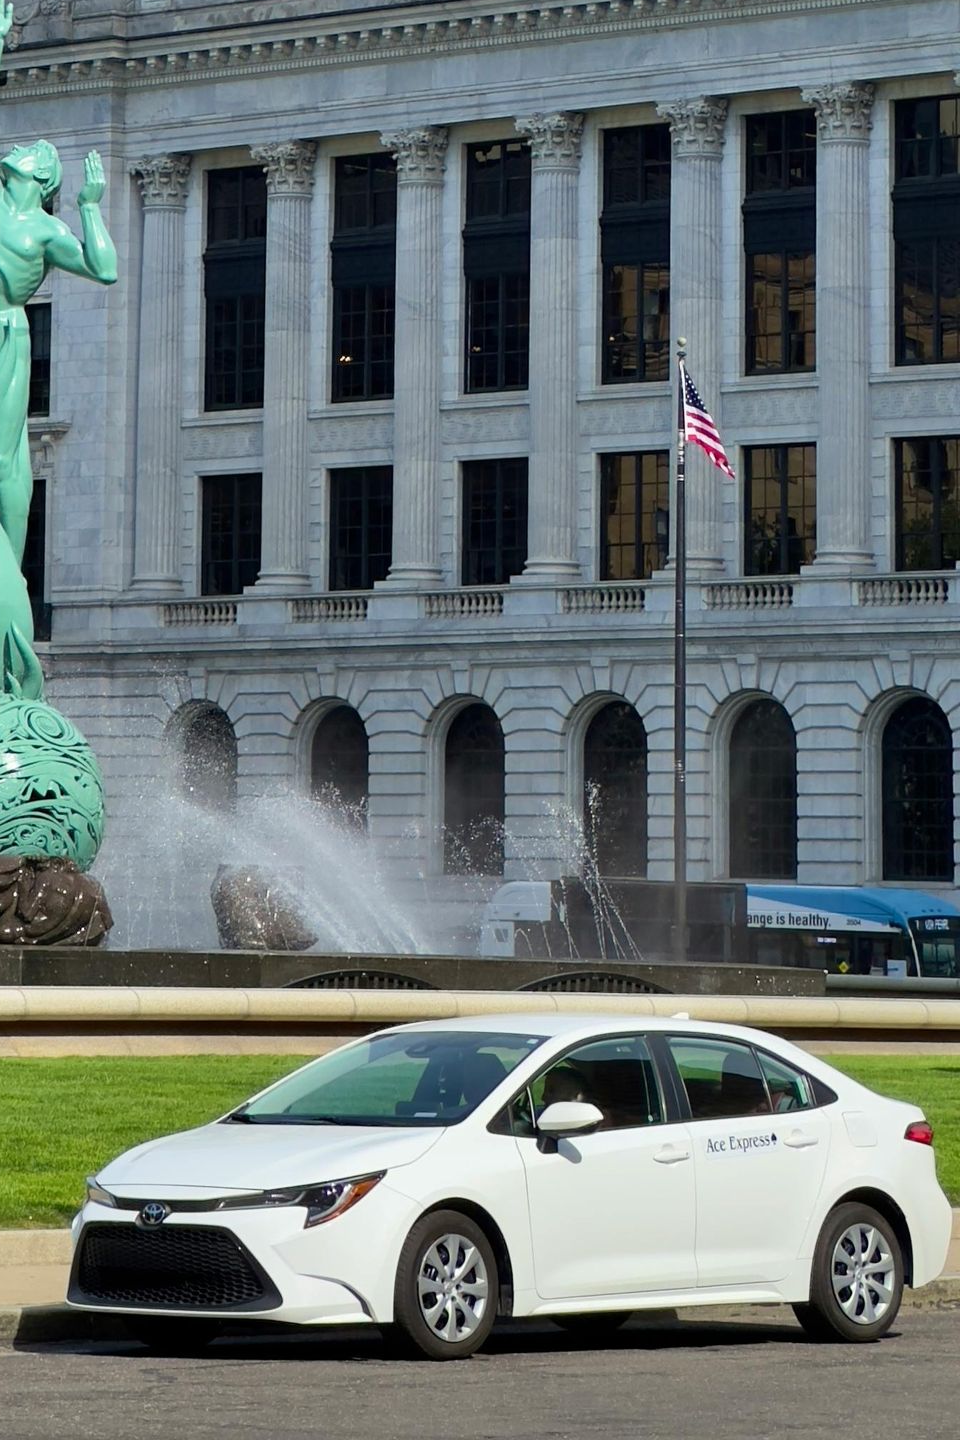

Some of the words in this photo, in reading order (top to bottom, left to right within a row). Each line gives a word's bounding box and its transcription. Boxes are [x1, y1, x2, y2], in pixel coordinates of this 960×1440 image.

[776, 912, 786, 925] is
[788, 912, 831, 930] healthy.
[706, 1138, 726, 1153] Ace
[729, 1134, 771, 1152] Express
